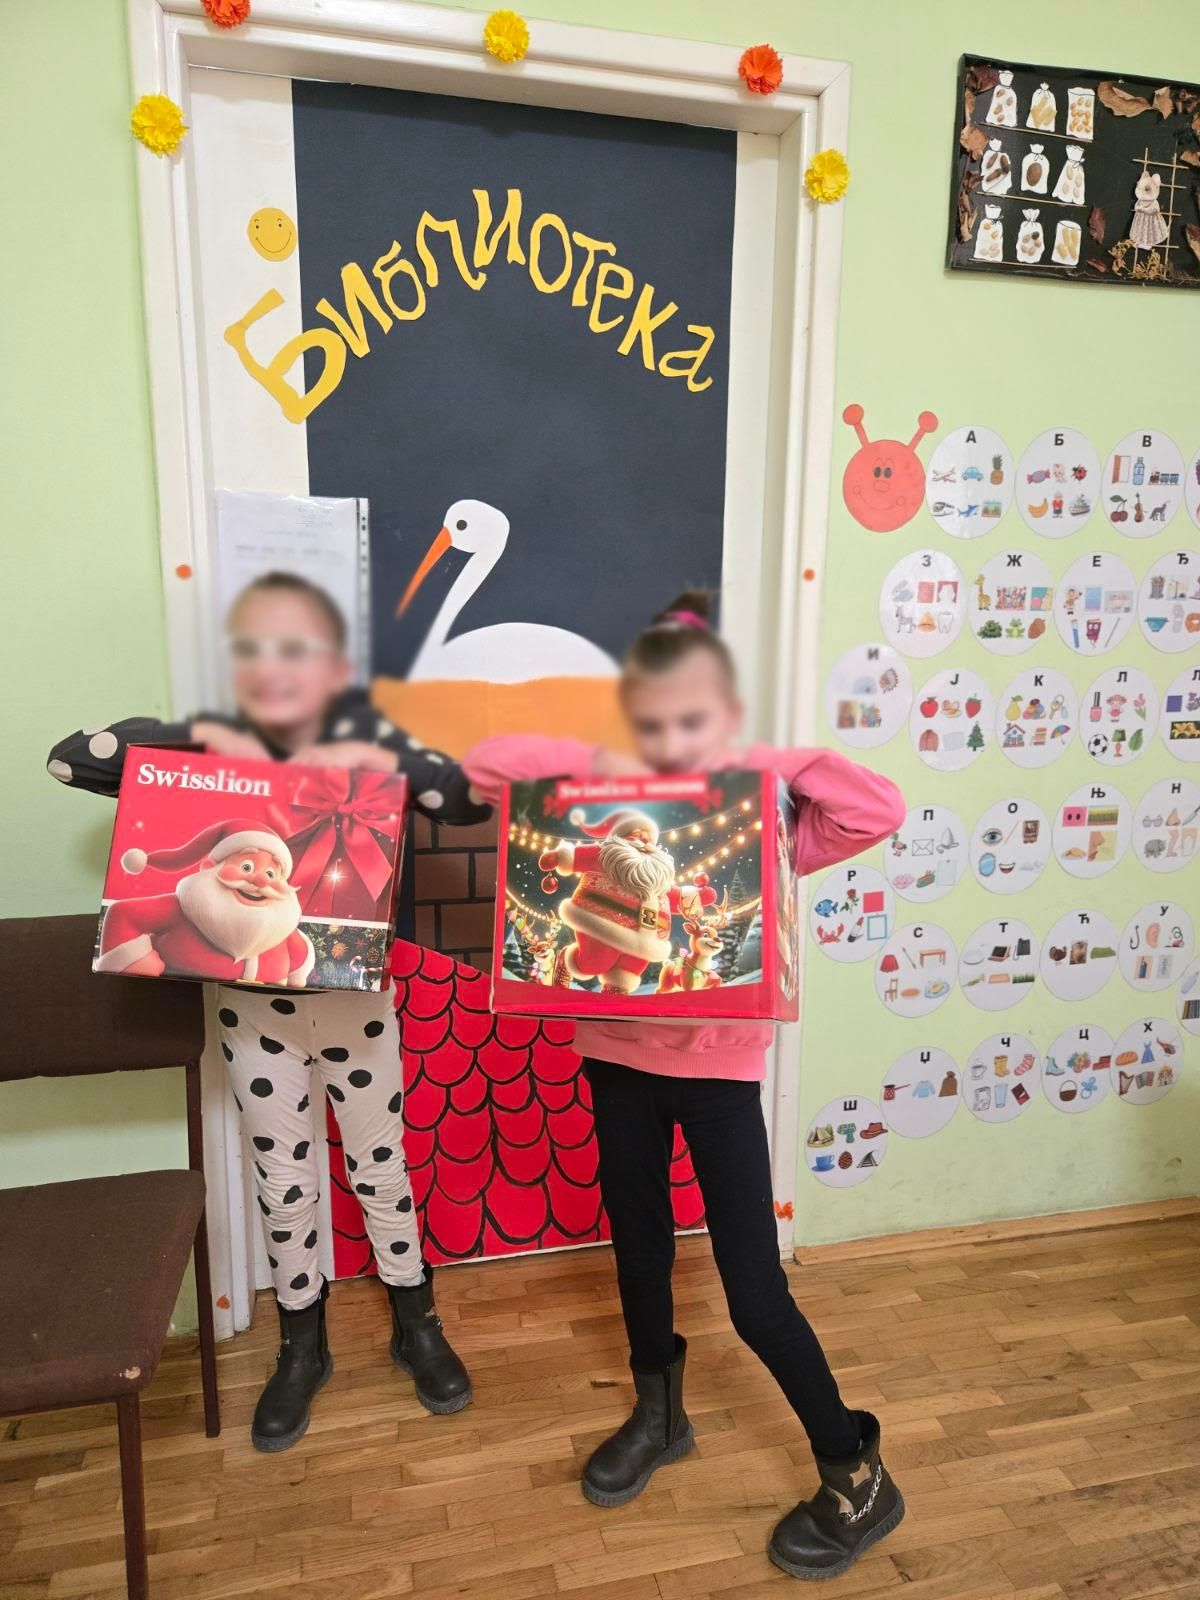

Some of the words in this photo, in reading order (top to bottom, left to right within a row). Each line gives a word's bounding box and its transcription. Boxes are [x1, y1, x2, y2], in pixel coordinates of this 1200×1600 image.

[965, 430, 977, 444] А
[1054, 433, 1064, 446] Б
[1142, 434, 1152, 448] В
[1006, 554, 1023, 567] Ж
[1092, 555, 1102, 568] Е
[1176, 552, 1189, 565] Ђ
[1034, 674, 1044, 687] К
[1116, 671, 1128, 683] Л
[137, 763, 272, 797] Swisslion
[1090, 787, 1106, 799] Њ
[1171, 782, 1182, 794] Н
[1007, 802, 1018, 814] О
[923, 809, 934, 821] П
[847, 870, 857, 882] Р
[1078, 913, 1090, 925] Ћ
[913, 926, 923, 939] С
[998, 921, 1009, 933] Т
[1143, 1021, 1153, 1033] Х
[1078, 1028, 1089, 1041] Ц
[1000, 1036, 1011, 1048] Ч
[843, 1099, 858, 1112] Ш
